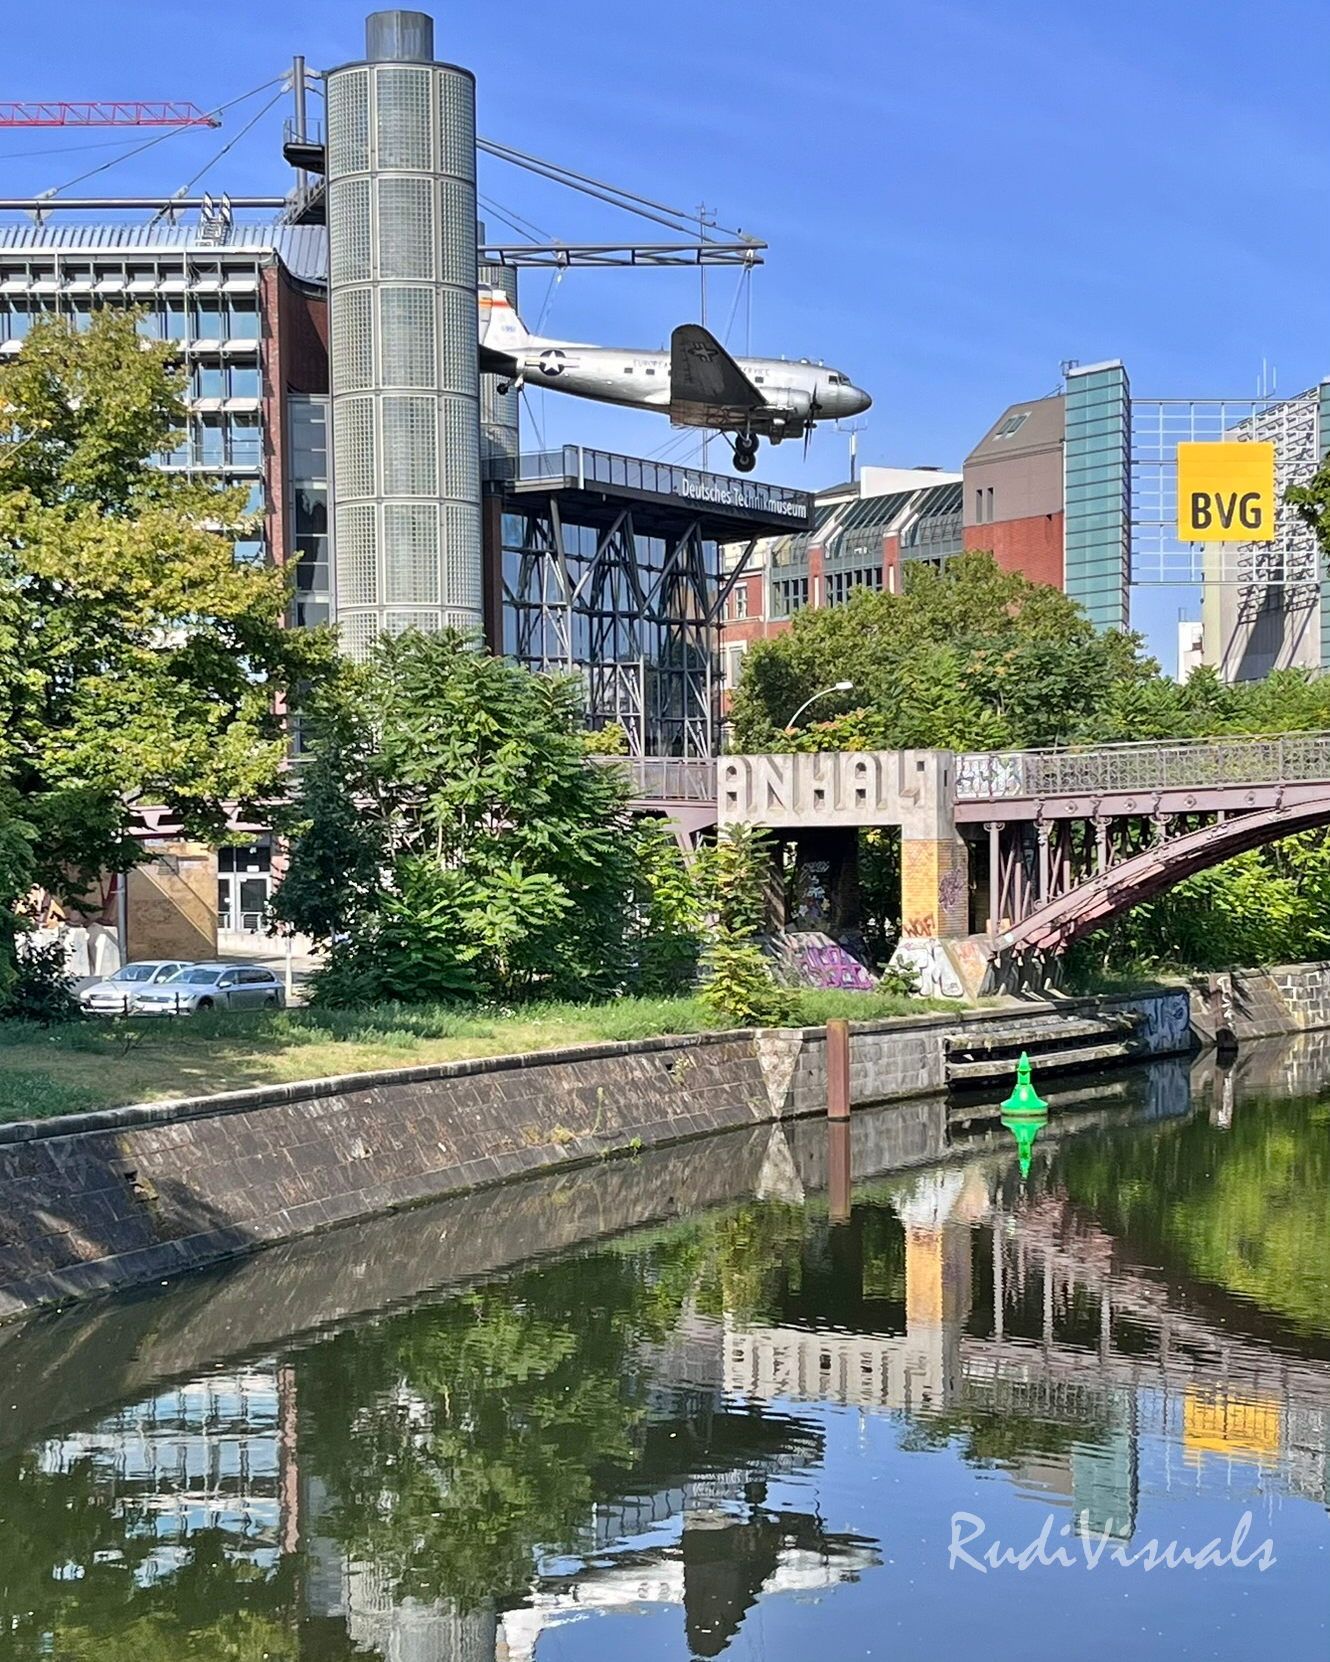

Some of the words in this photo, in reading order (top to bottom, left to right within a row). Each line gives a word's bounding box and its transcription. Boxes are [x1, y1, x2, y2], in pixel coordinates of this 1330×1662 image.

[682, 478, 731, 504] Deutsches
[733, 487, 807, 519] Technikmuseum
[1191, 492, 1262, 530] BVG
